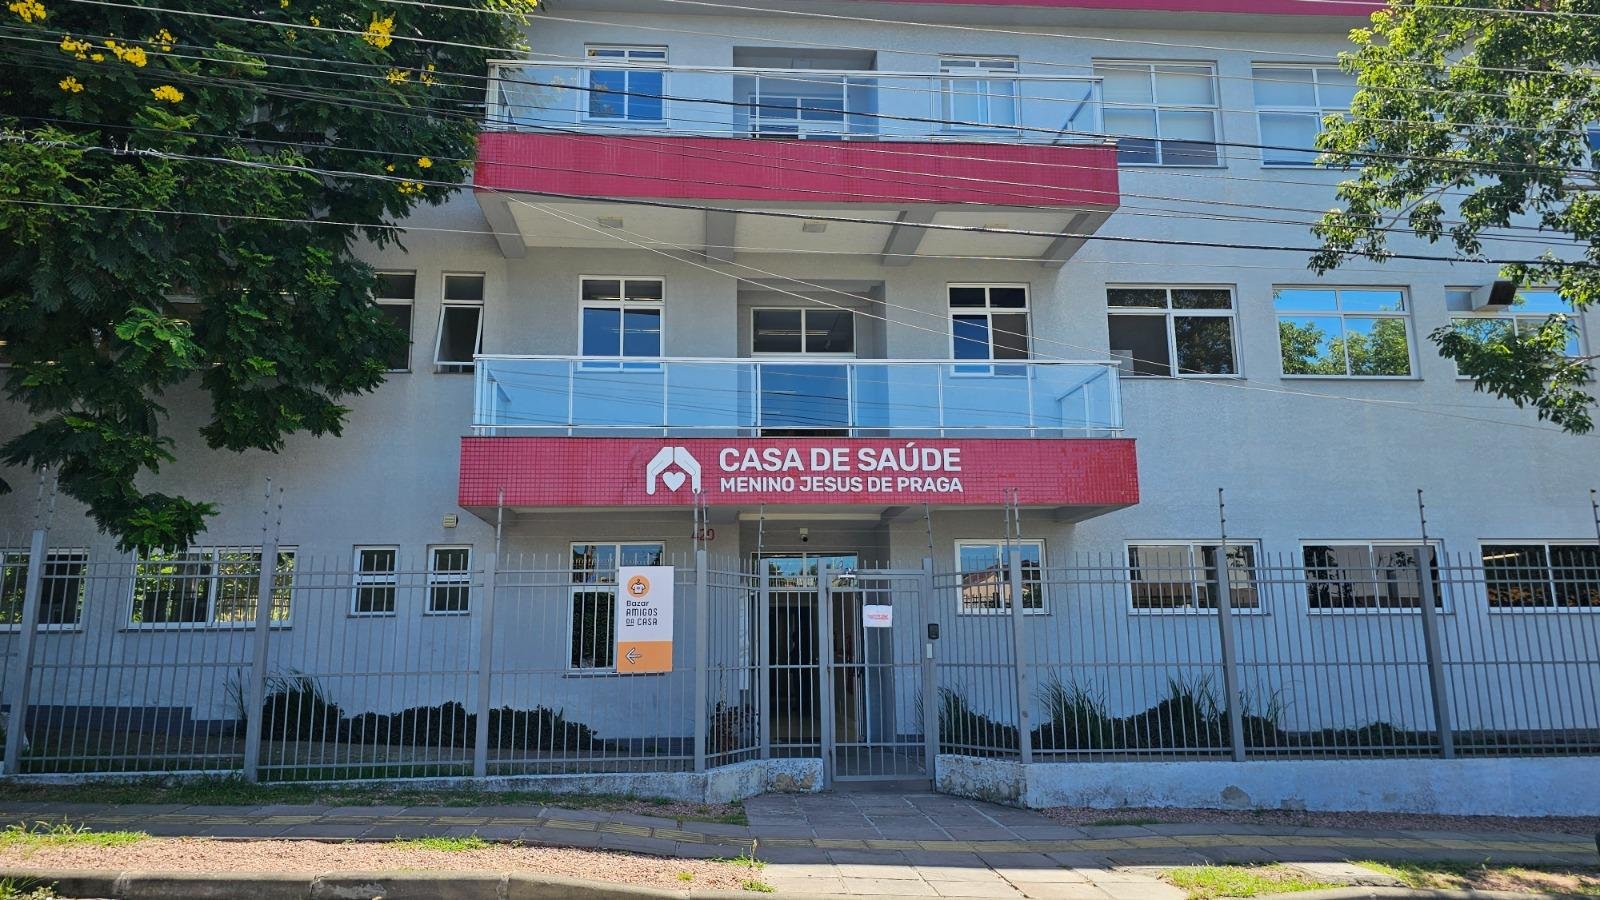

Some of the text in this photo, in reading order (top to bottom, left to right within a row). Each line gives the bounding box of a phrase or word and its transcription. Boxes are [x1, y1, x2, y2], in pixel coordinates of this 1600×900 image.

[719, 441, 962, 472] CASA DE SAÚDE
[720, 476, 963, 493] MENINO JESUS DE PRAGA
[626, 608, 658, 616] AMIGOS
[637, 618, 658, 626] CASA
